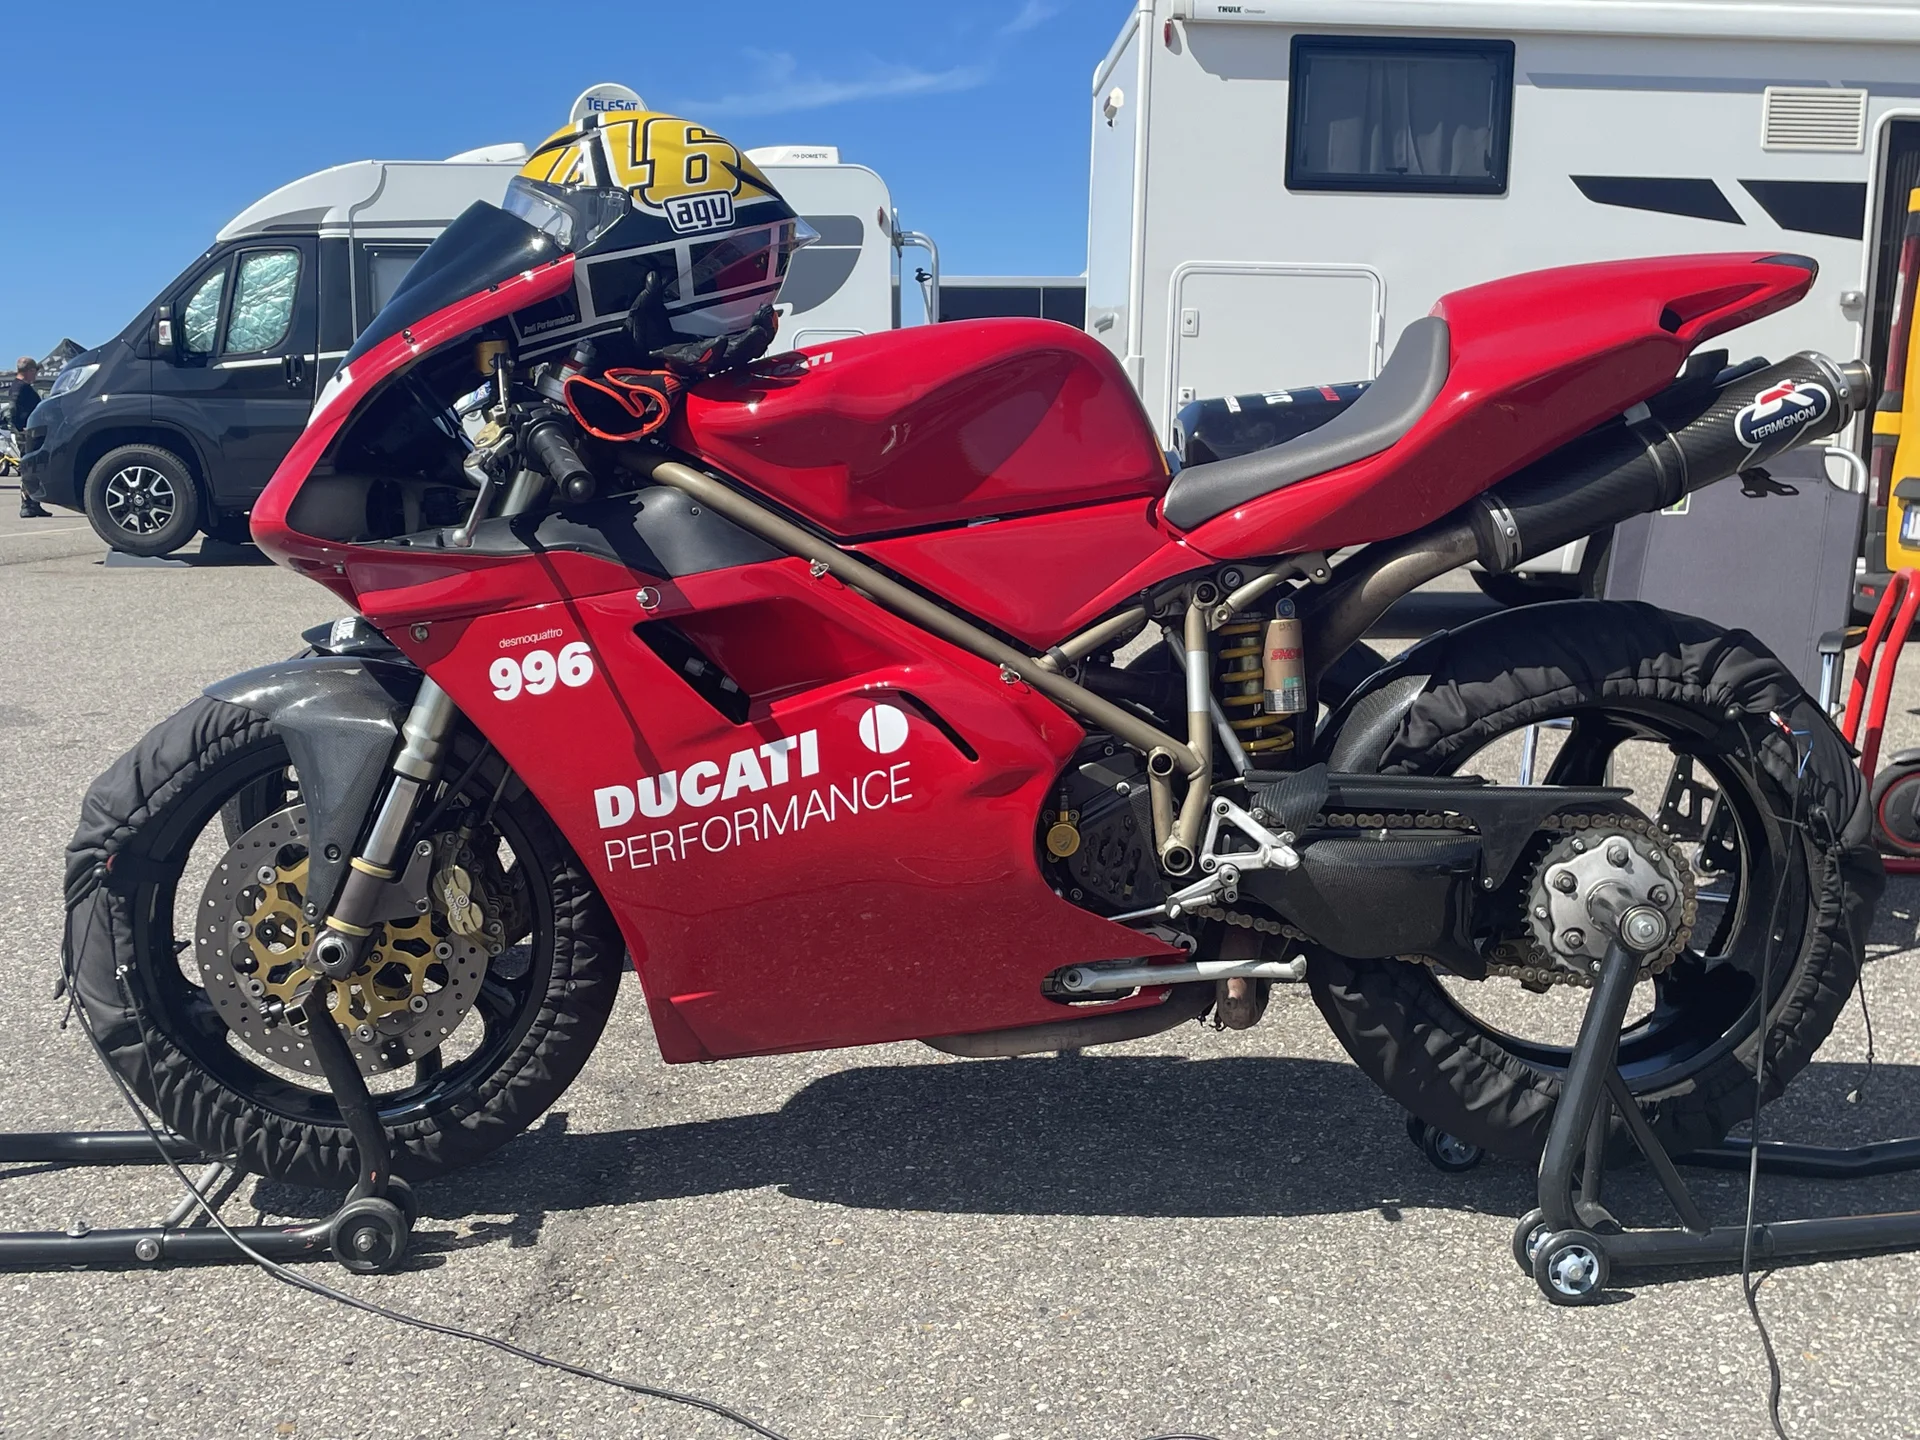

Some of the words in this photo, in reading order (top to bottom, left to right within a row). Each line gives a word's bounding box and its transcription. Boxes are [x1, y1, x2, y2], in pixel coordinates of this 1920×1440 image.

[674, 195, 728, 229] agv
[751, 405, 817, 440] TERMIGNONI
[498, 628, 563, 649] desmoquattro
[489, 641, 594, 701] 996
[594, 729, 819, 829] DUCATI
[604, 761, 913, 872] PERFORMANCE
